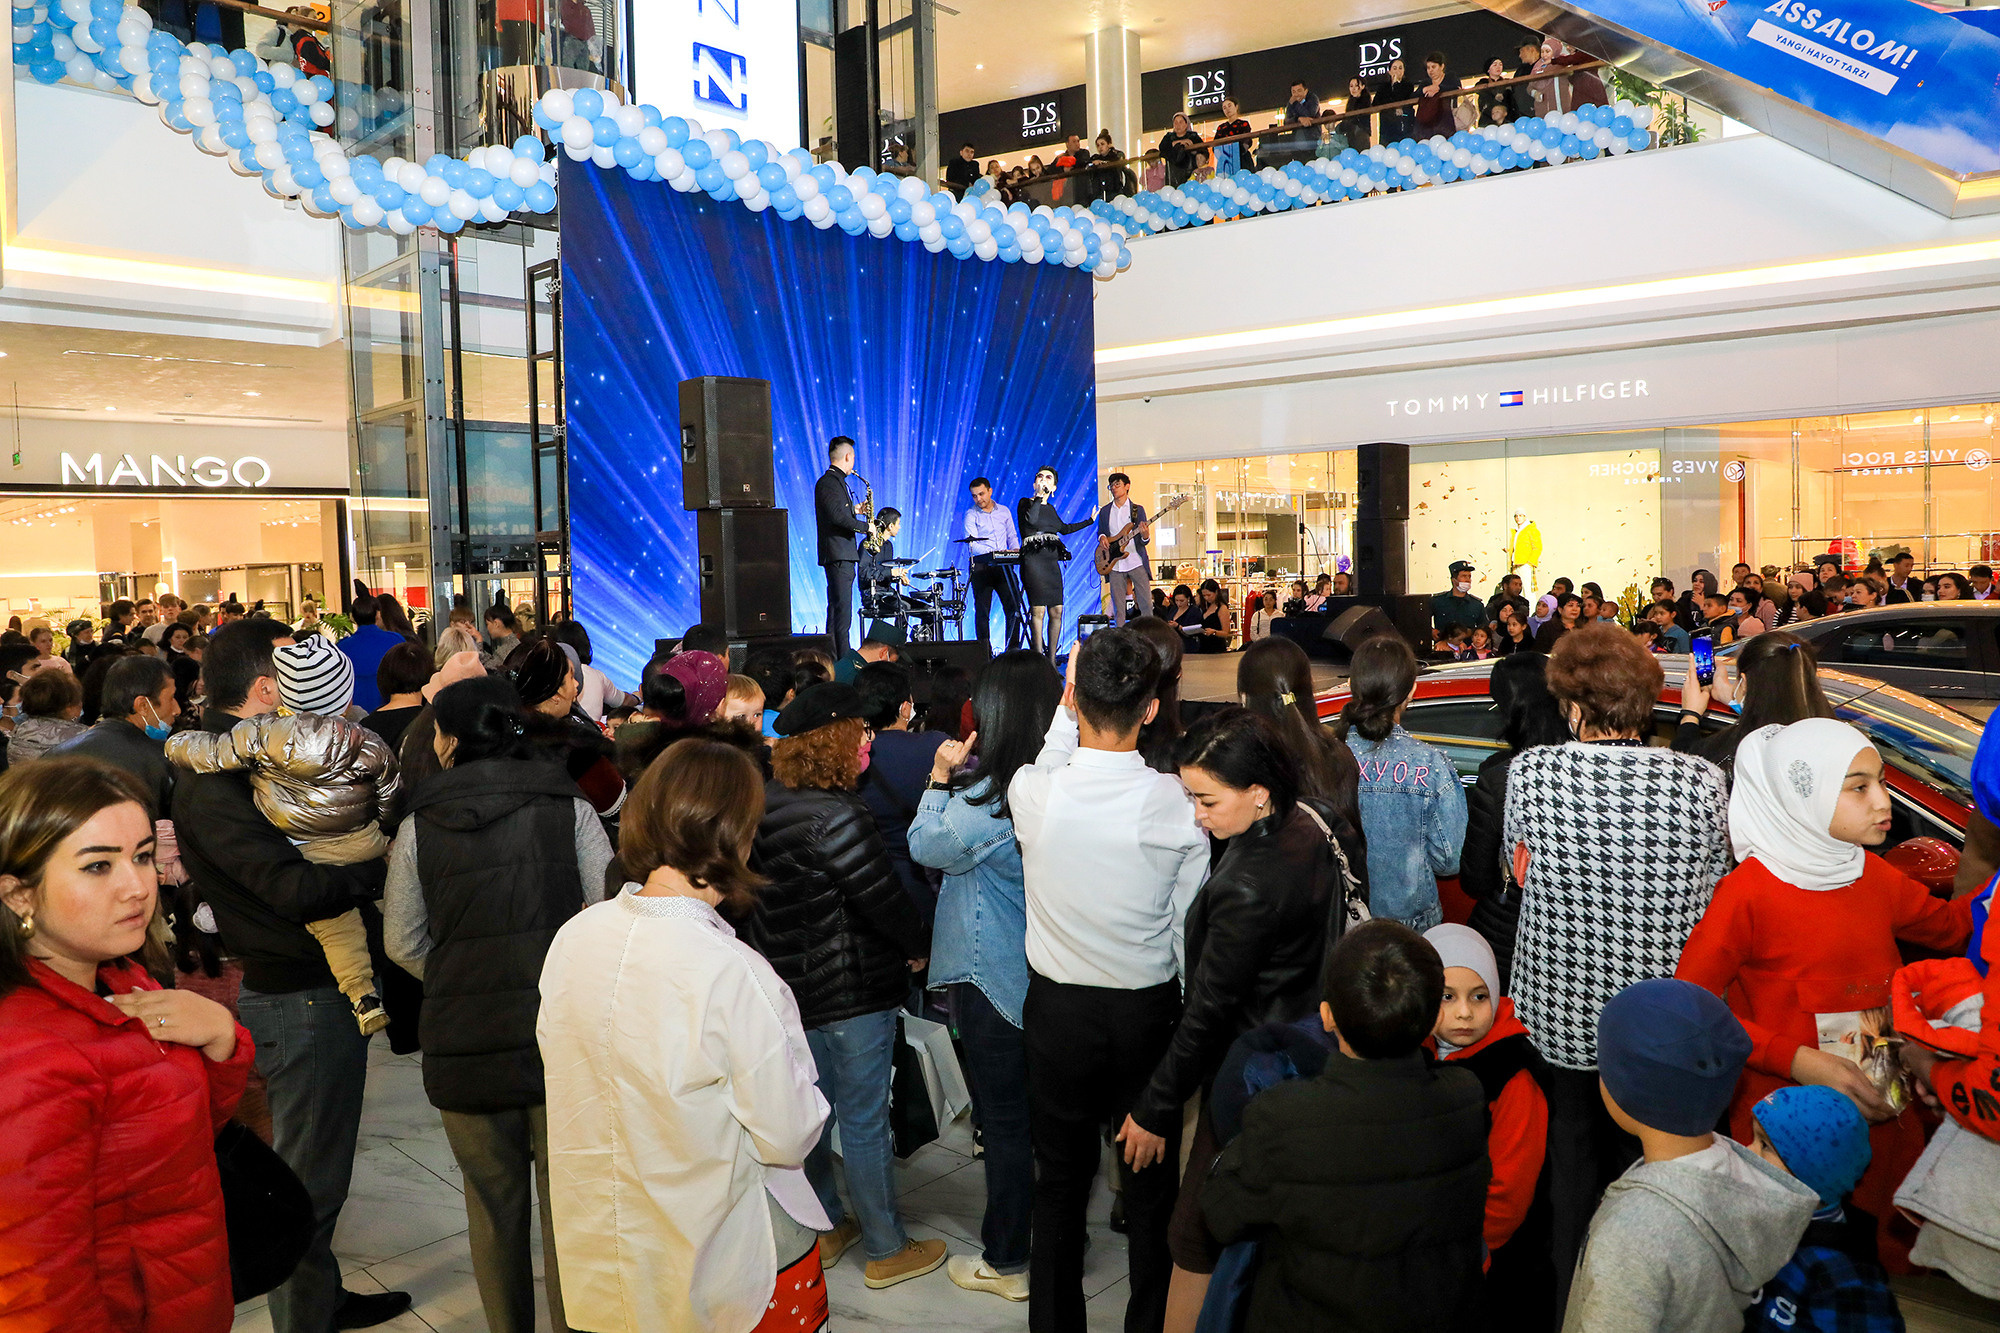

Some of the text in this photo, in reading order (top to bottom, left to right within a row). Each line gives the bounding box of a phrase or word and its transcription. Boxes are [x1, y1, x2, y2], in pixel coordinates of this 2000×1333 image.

[1764, 0, 1918, 69] ASSALOM!
[1359, 65, 1390, 78] dam
[1775, 34, 1870, 79] YANGI HAYOT TARZI
[1187, 92, 1226, 108] damat
[1022, 124, 1057, 138] damat
[1386, 379, 1650, 417] TOMMY HILFIGER
[61, 452, 271, 487] MANGO
